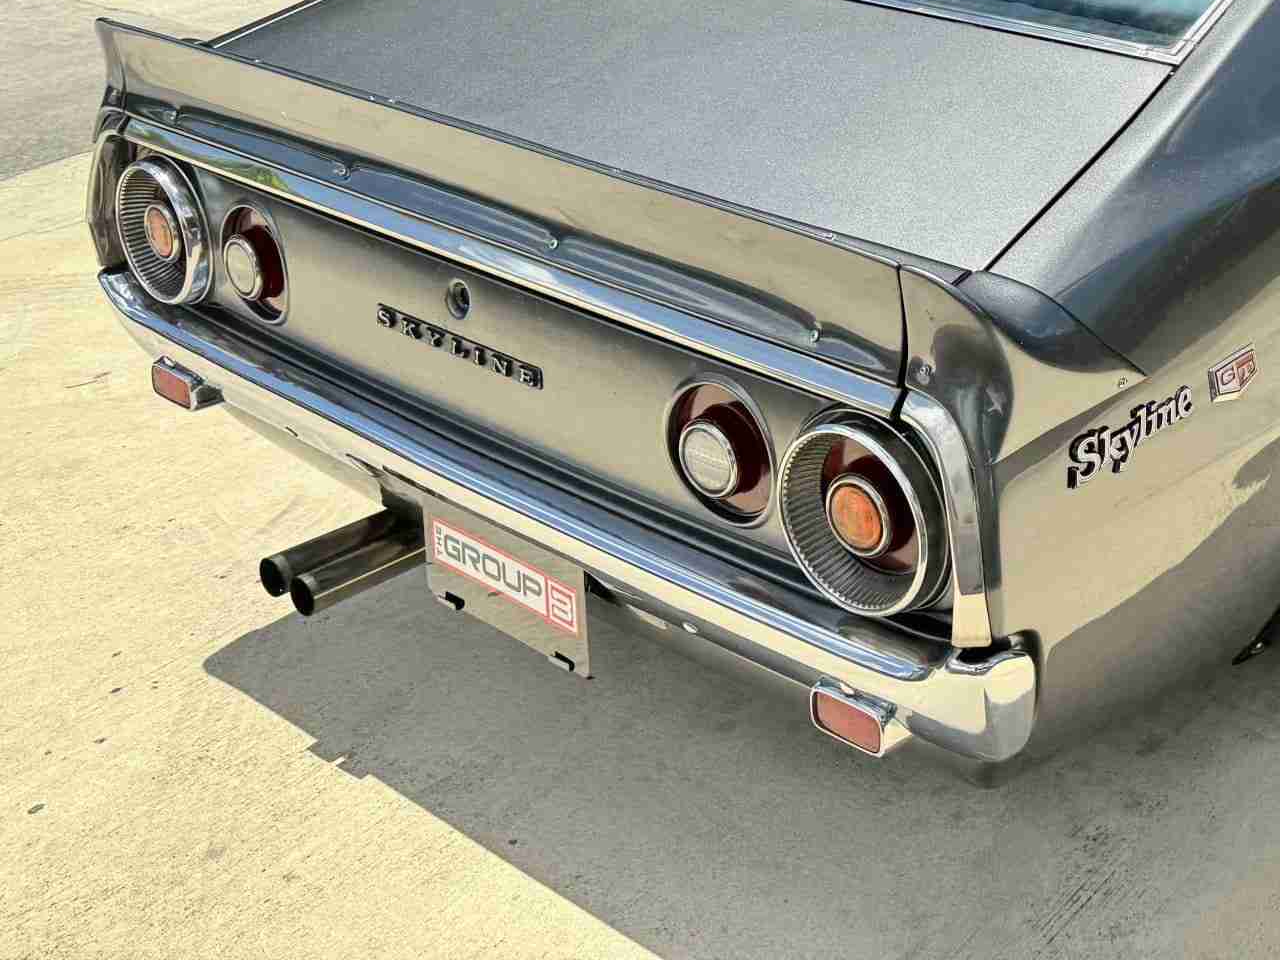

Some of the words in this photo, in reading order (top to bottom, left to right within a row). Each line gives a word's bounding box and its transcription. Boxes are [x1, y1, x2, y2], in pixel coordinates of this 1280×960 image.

[376, 307, 539, 388] SKYLINE
[1066, 384, 1193, 490] Skyline
[443, 533, 544, 598] GROUP
